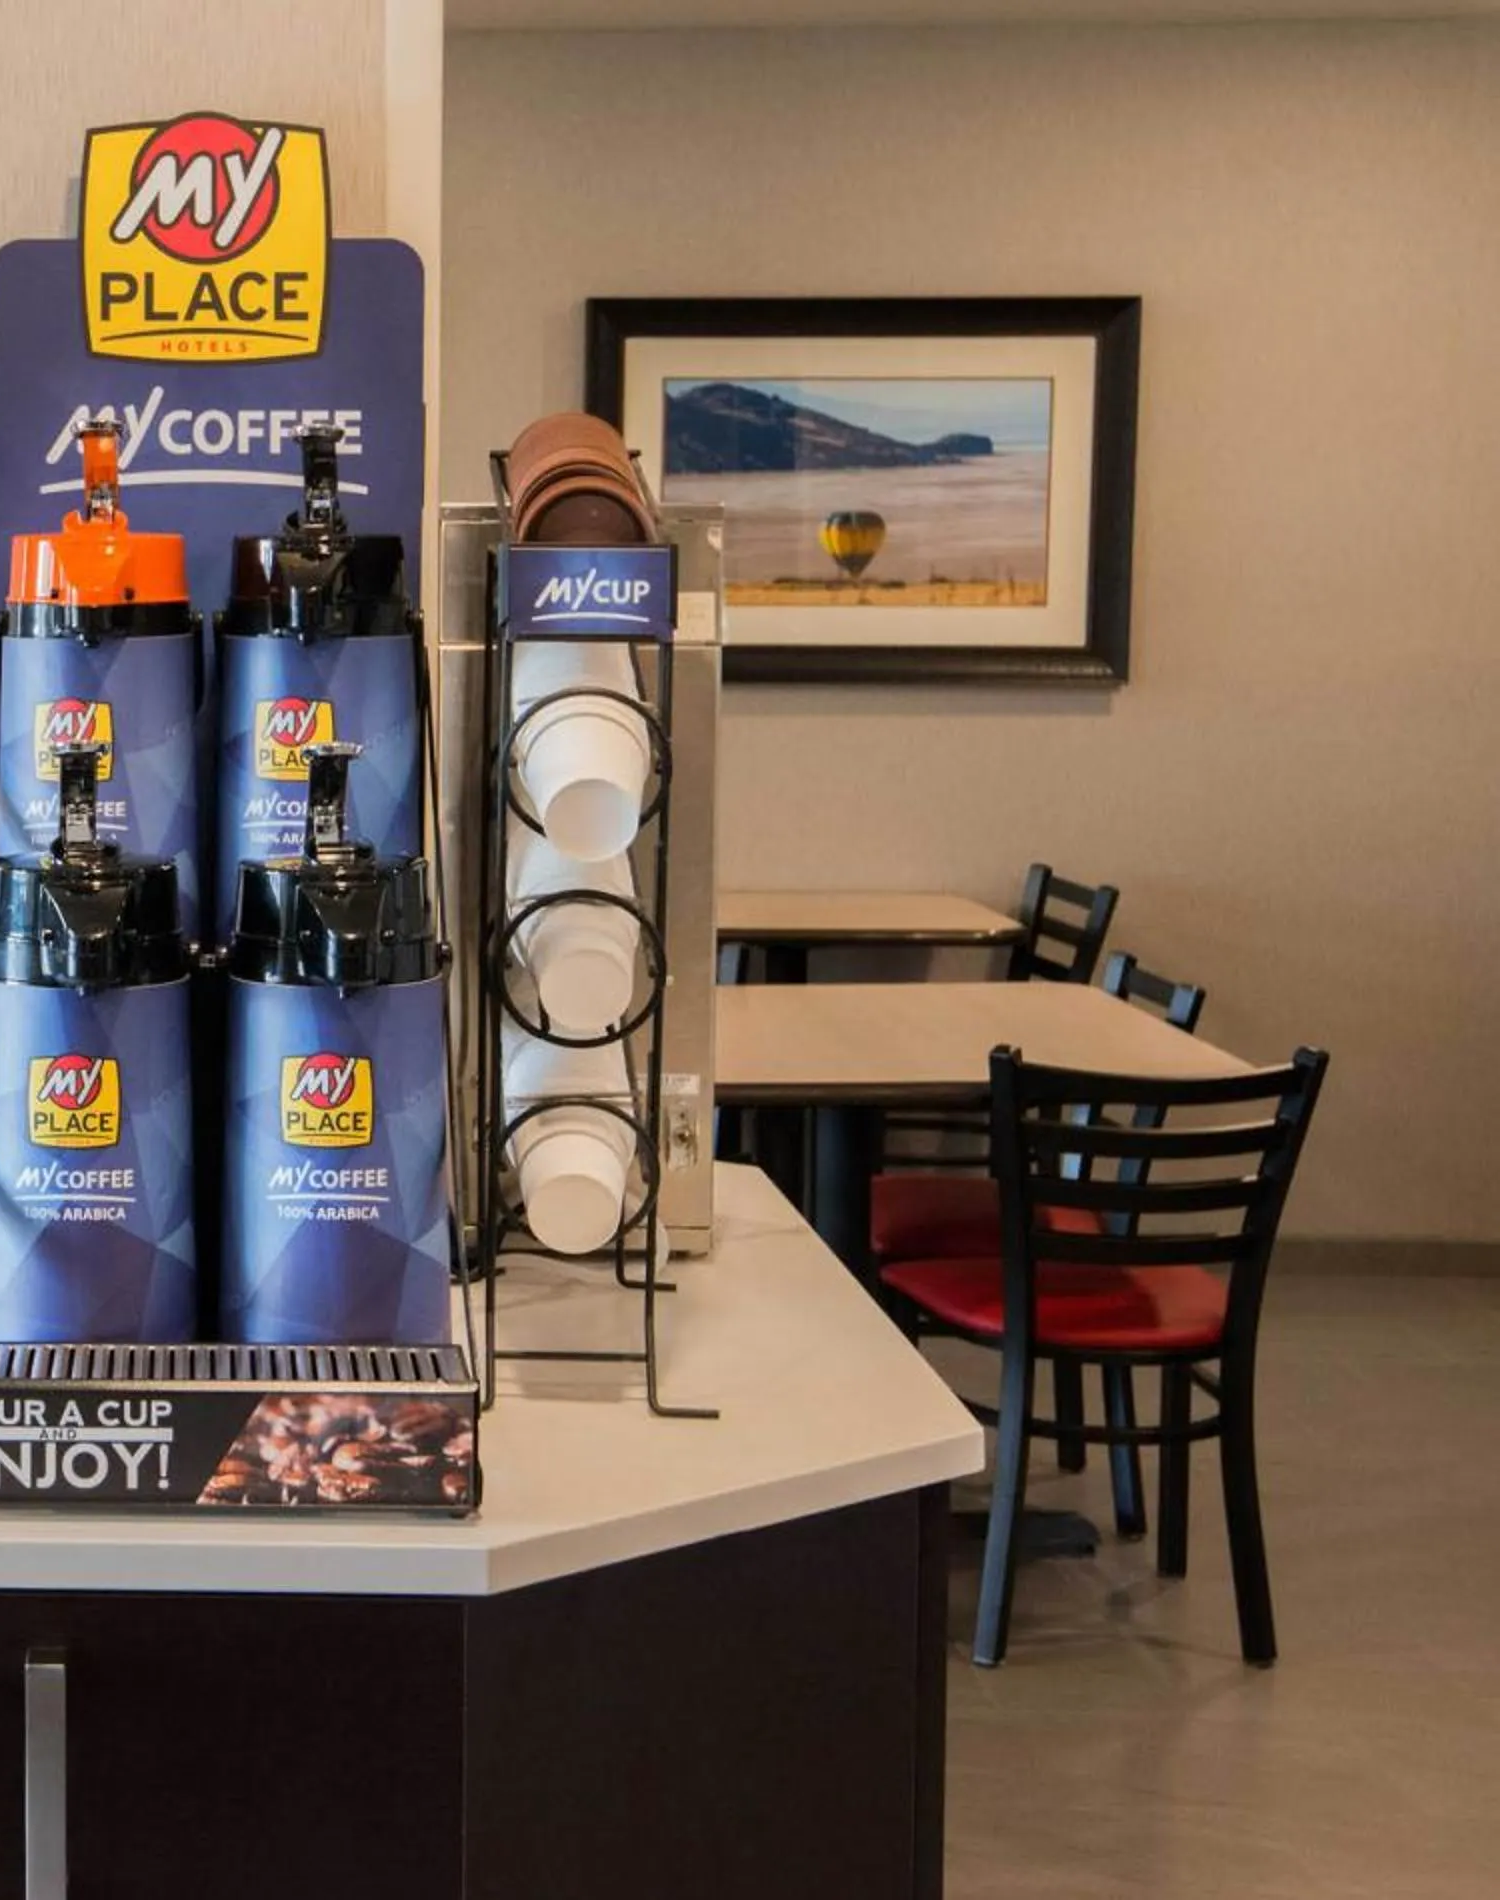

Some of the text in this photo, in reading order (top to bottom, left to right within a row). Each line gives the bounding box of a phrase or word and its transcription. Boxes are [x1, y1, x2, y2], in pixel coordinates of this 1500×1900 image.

[100, 271, 310, 321] PLACE
[160, 340, 248, 353] HOTELS
[34, 1111, 114, 1132] PLACE
[286, 1110, 367, 1132] PLACE
[24, 1206, 126, 1221] 100% ARABICA
[277, 1205, 380, 1221] 100% ARABICA
[59, 1400, 85, 1427] A
[97, 1400, 173, 1427] CUP
[39, 1429, 77, 1440] AND
